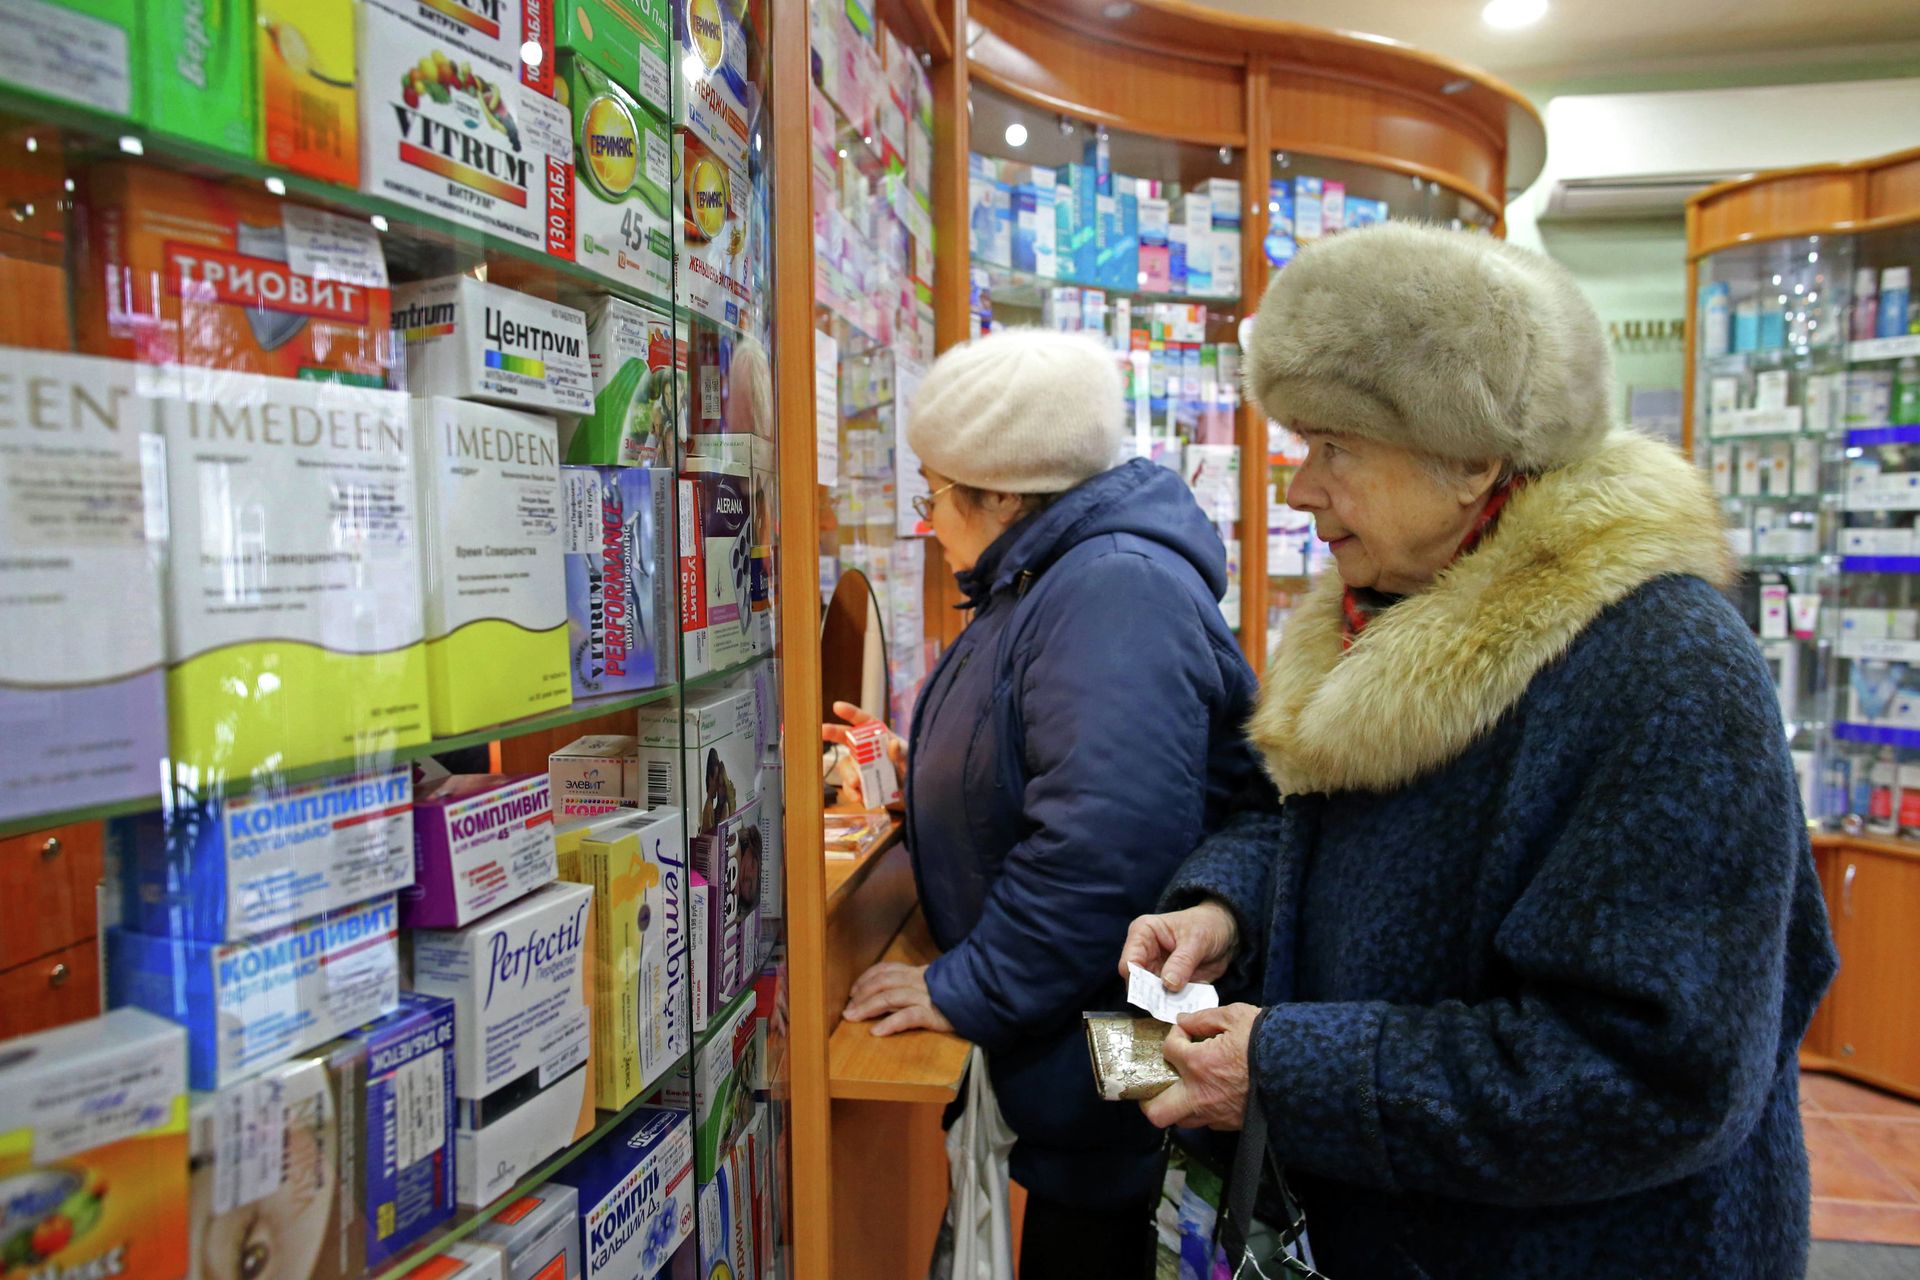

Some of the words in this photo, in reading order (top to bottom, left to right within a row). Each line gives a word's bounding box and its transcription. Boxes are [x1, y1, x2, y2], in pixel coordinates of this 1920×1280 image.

[694, 79, 728, 122] НЕРДЖИ
[389, 101, 528, 190] VITRUM
[591, 135, 633, 158] ГЕРИМАКС
[696, 191, 722, 209] ГЕРИМАКС
[550, 215, 566, 250] 130
[172, 255, 361, 313] ТРИОВИТ
[188, 400, 404, 454] IMEDEEN
[446, 423, 555, 467] IMEDEEN
[716, 498, 743, 514] ALERANA
[601, 500, 625, 676] PERFORMANCE
[623, 525, 633, 599] ПЕРФОМЕНС
[589, 570, 604, 678] VITRUM
[624, 602, 633, 650] ВИТРУМ
[230, 775, 408, 838] КОМПЛИВИТ
[451, 789, 549, 842] КОМПЛИВИТ
[220, 904, 394, 987] КОМПЛИВИТ
[484, 904, 585, 1011] Perfectil
